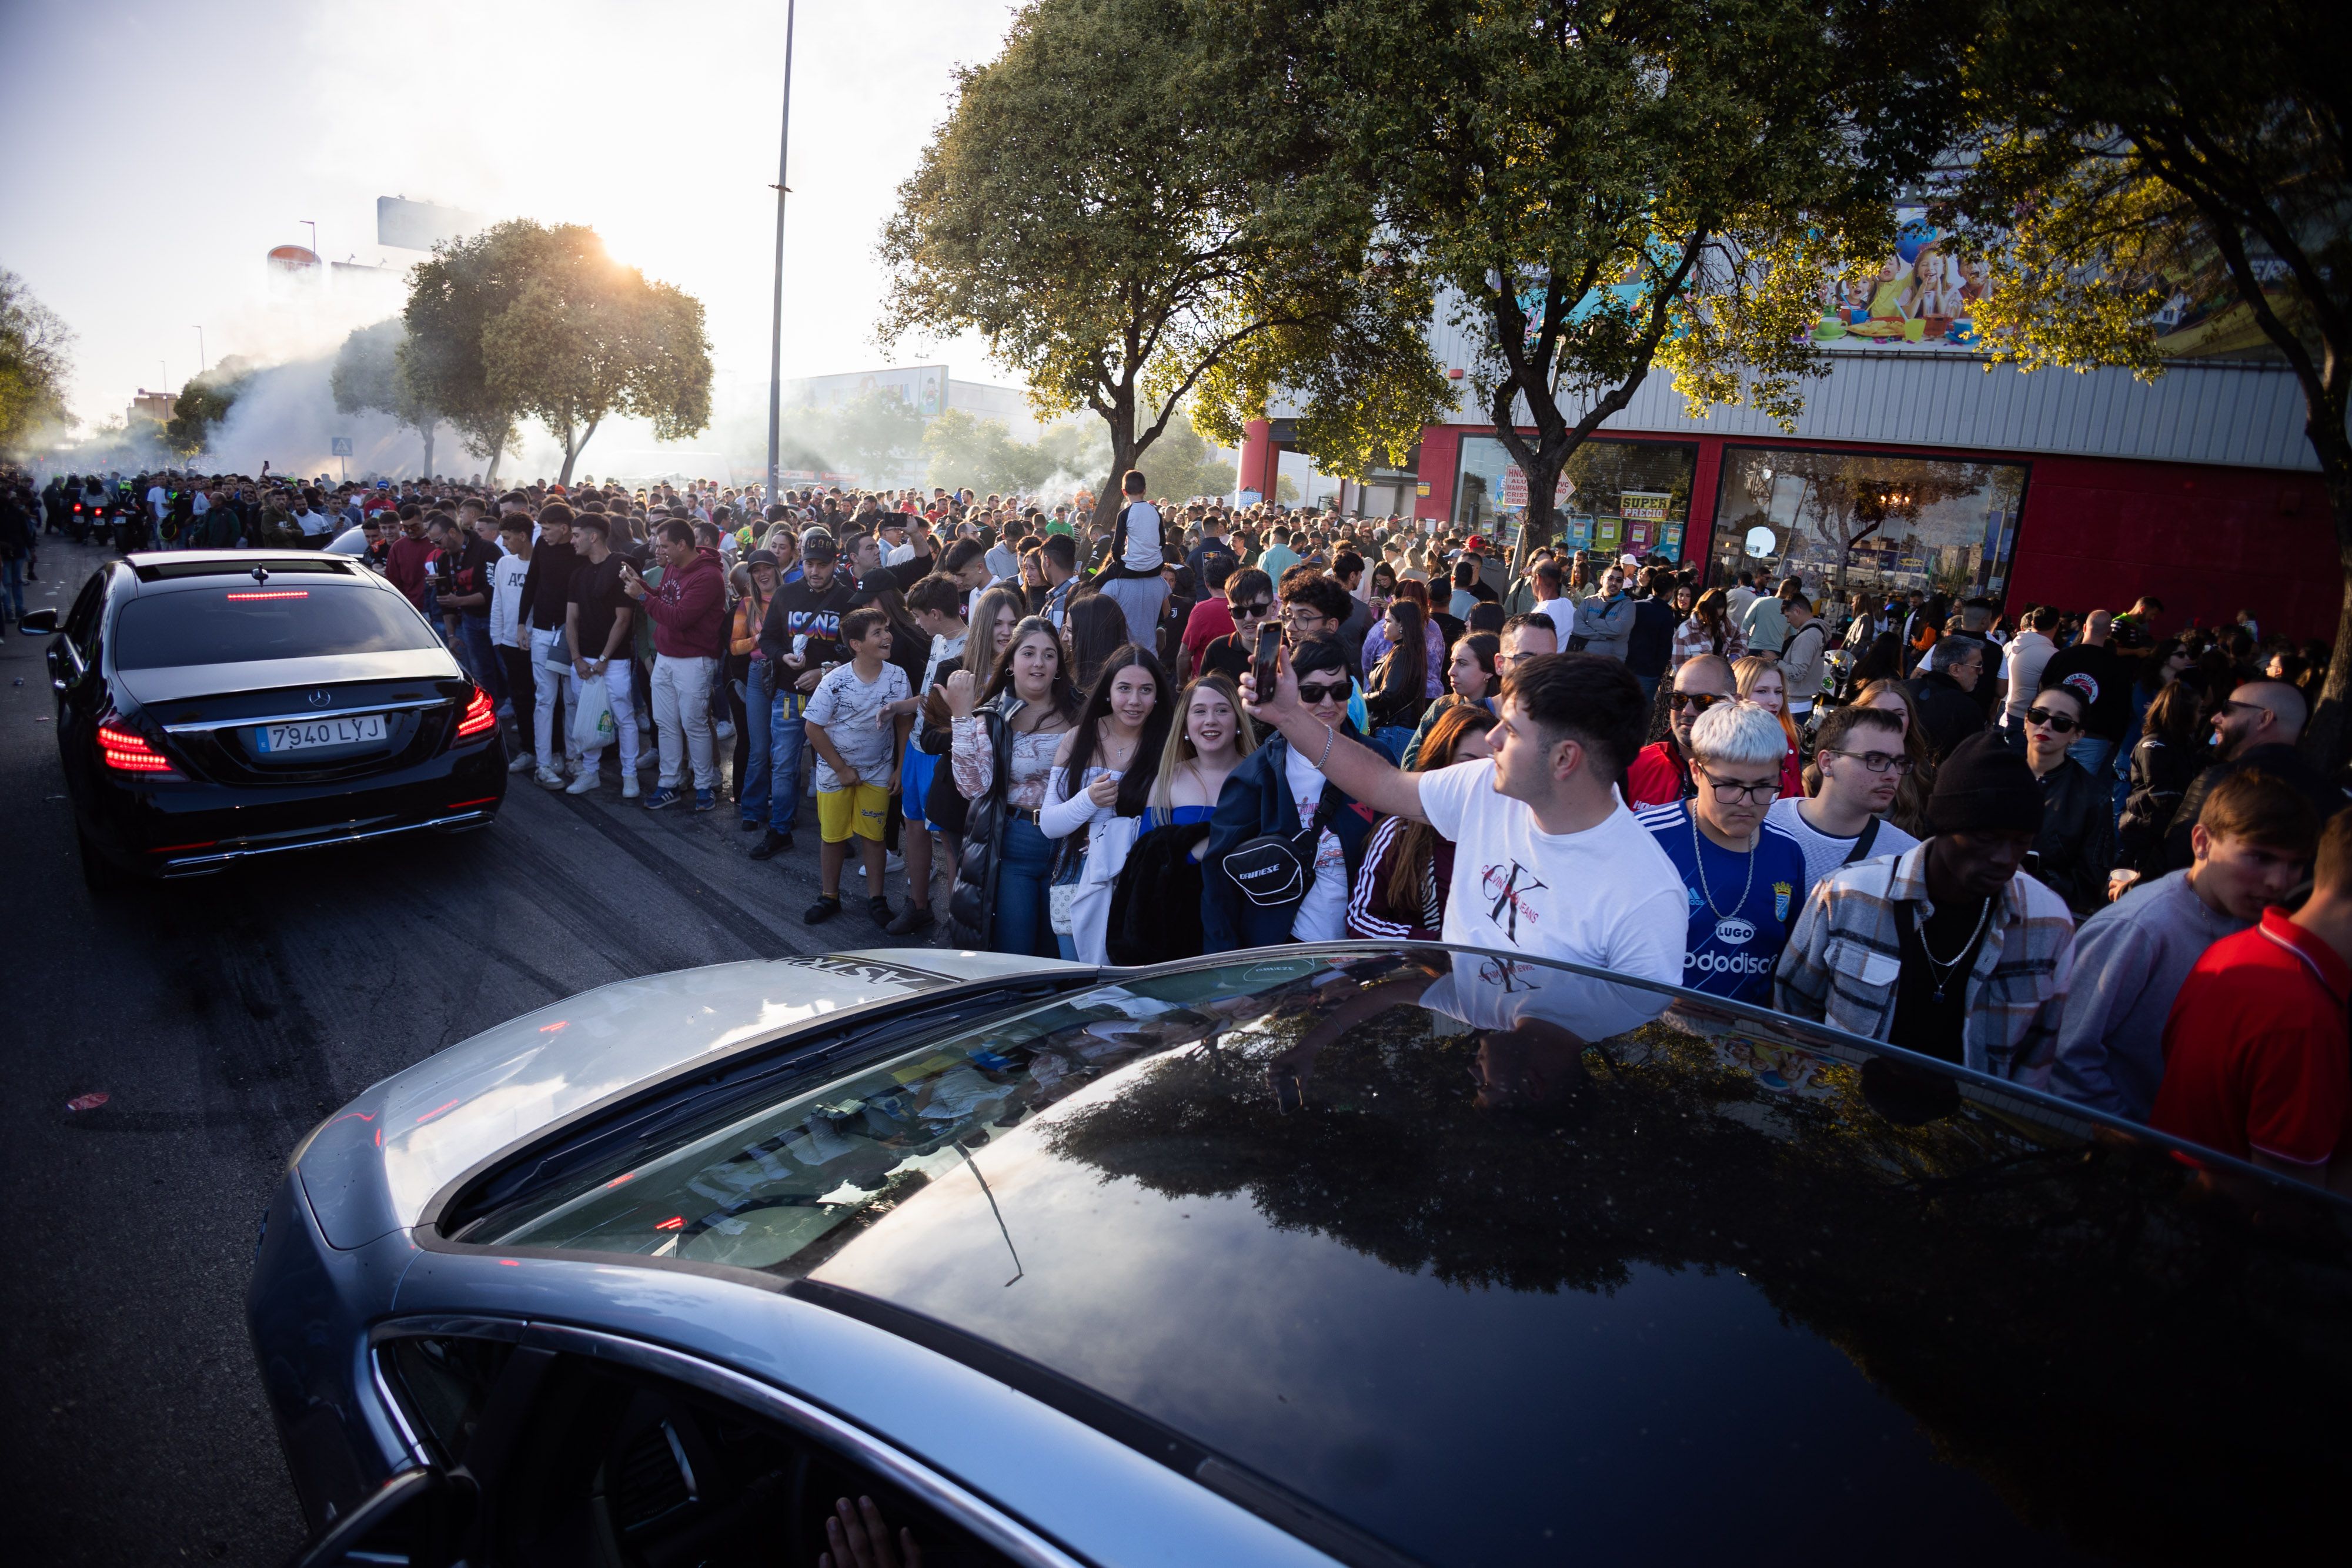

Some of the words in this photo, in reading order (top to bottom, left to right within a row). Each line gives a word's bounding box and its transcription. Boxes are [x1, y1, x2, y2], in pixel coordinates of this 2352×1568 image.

[1622, 497, 1668, 508] SUPER
[1624, 508, 1663, 518] PRECIO
[273, 725, 330, 748] 7940
[338, 719, 379, 741] LYJ
[1240, 863, 1280, 880] DAINESE
[1519, 902, 1539, 924] JEANS
[1718, 927, 1753, 939] LUGO
